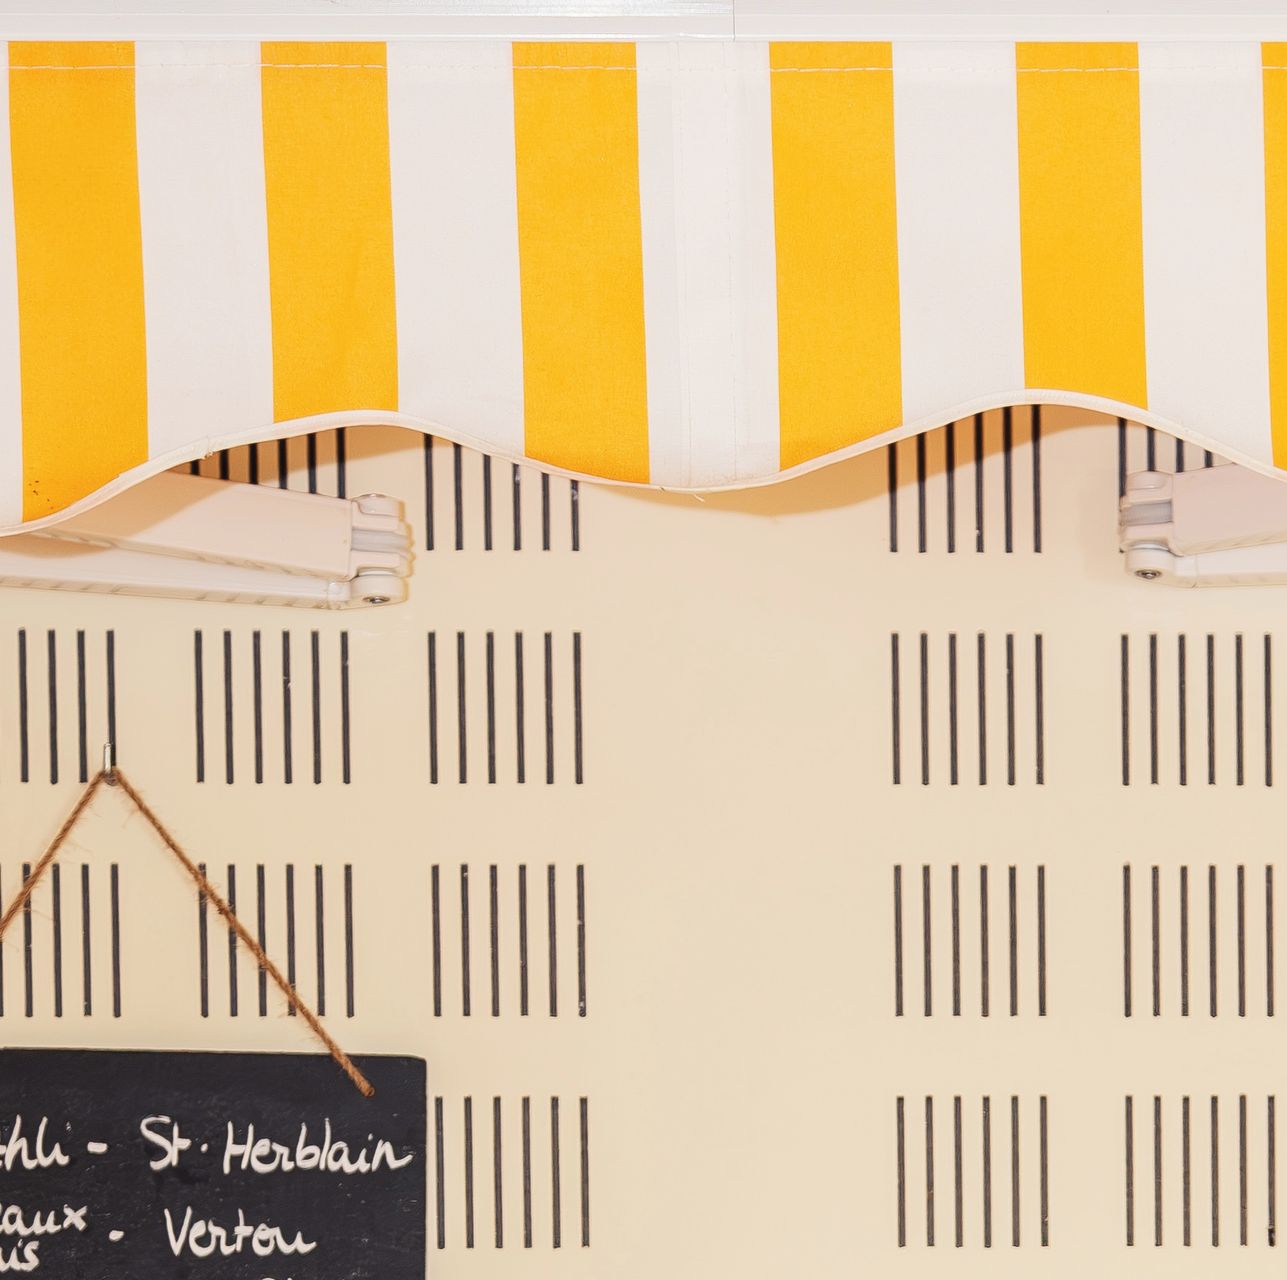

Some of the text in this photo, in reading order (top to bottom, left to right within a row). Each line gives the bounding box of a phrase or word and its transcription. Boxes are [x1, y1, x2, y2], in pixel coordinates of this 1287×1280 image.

[223, 1118, 414, 1175] Herblain
[0, 1203, 318, 1257] aux Vertou
